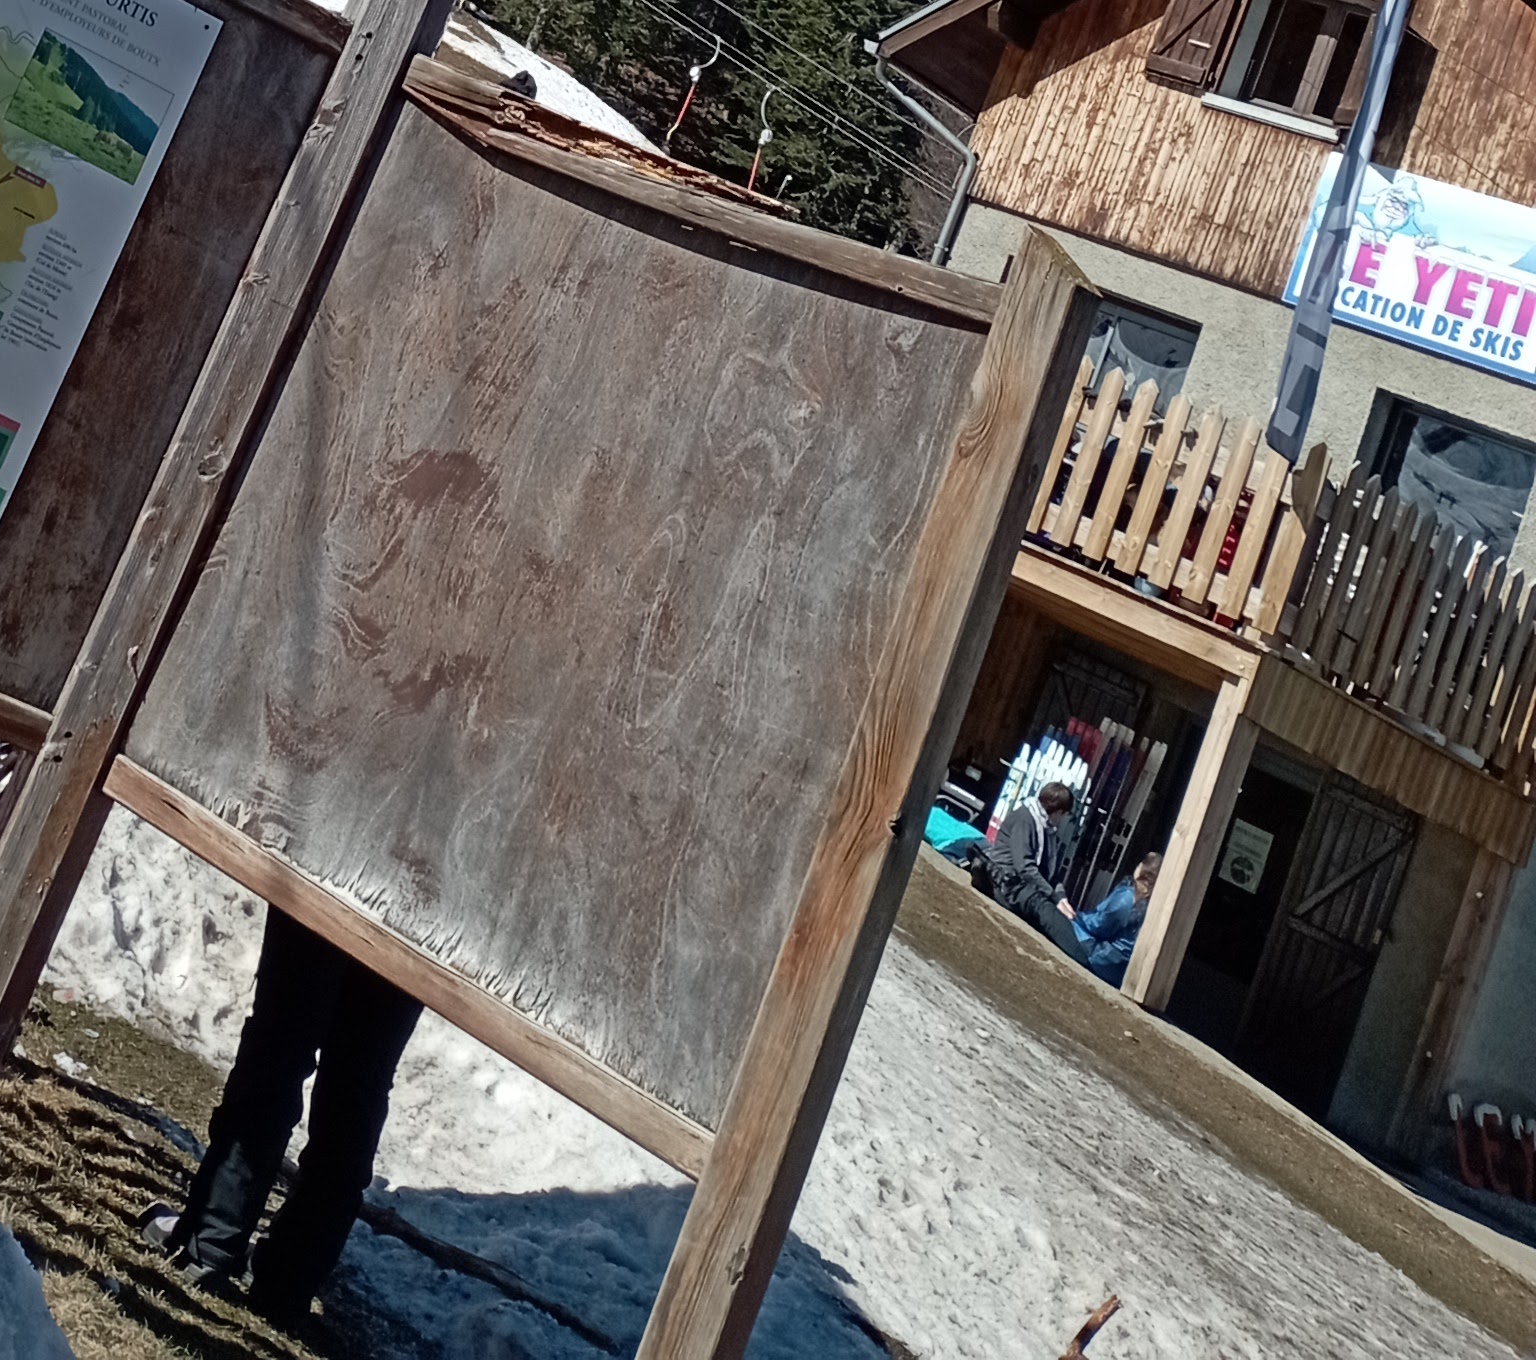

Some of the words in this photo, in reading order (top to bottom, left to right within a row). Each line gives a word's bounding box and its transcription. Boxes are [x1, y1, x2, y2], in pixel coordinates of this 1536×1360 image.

[111, 34, 124, 46] DE
[126, 43, 159, 66] BOUTX
[1340, 286, 1426, 330] CATION
[1432, 314, 1464, 343] DE
[1469, 327, 1525, 362] SKIS
[1348, 243, 1388, 289] E
[1413, 255, 1536, 338] YETI
